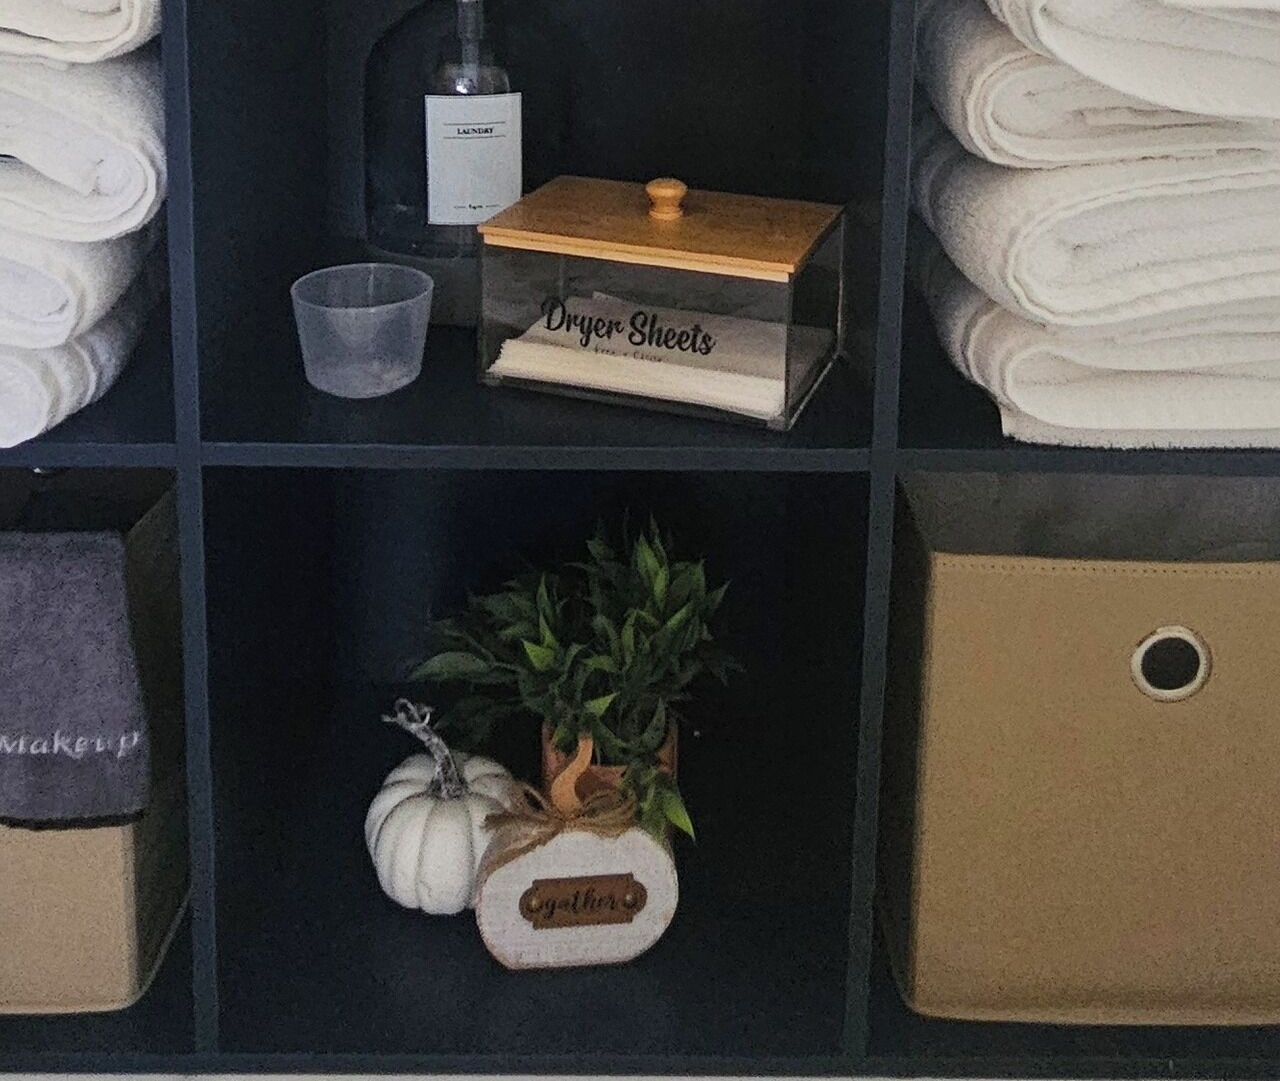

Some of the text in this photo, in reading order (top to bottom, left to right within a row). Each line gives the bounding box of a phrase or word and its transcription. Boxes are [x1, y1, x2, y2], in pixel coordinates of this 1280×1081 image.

[457, 127, 494, 135] LAUNDRY
[540, 295, 716, 356] Dryer Sheets
